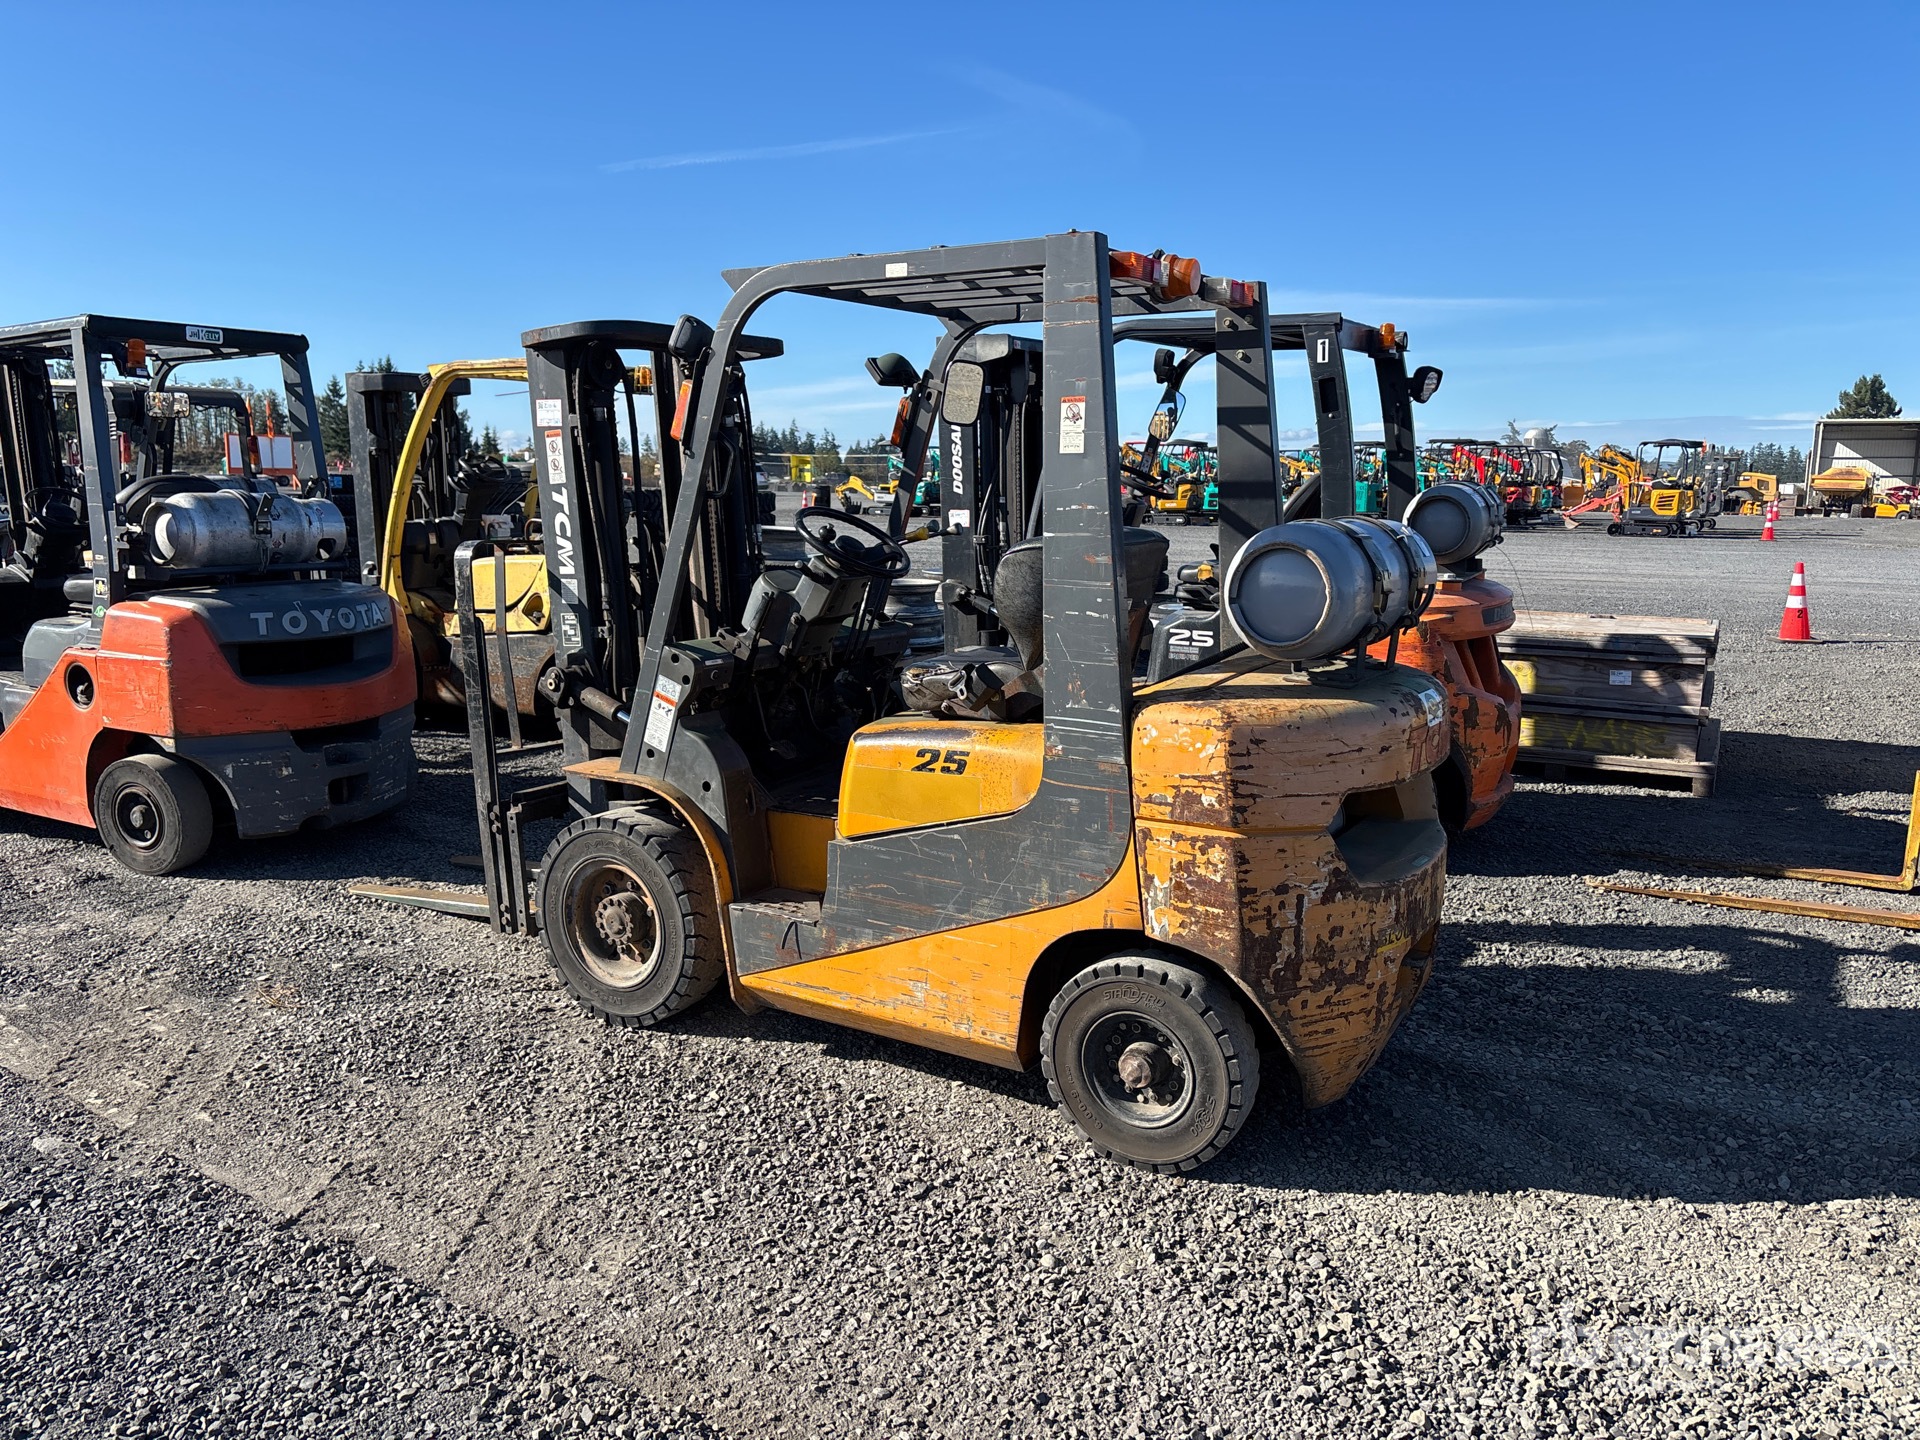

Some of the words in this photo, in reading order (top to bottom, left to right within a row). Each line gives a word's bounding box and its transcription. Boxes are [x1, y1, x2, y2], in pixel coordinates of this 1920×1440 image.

[1320, 340, 1326, 361] 1
[551, 486, 576, 575] TCM
[249, 601, 385, 637] TOYOTA
[1168, 628, 1215, 648] 25
[911, 748, 971, 776] 25
[1103, 984, 1167, 1008] STANDARD
